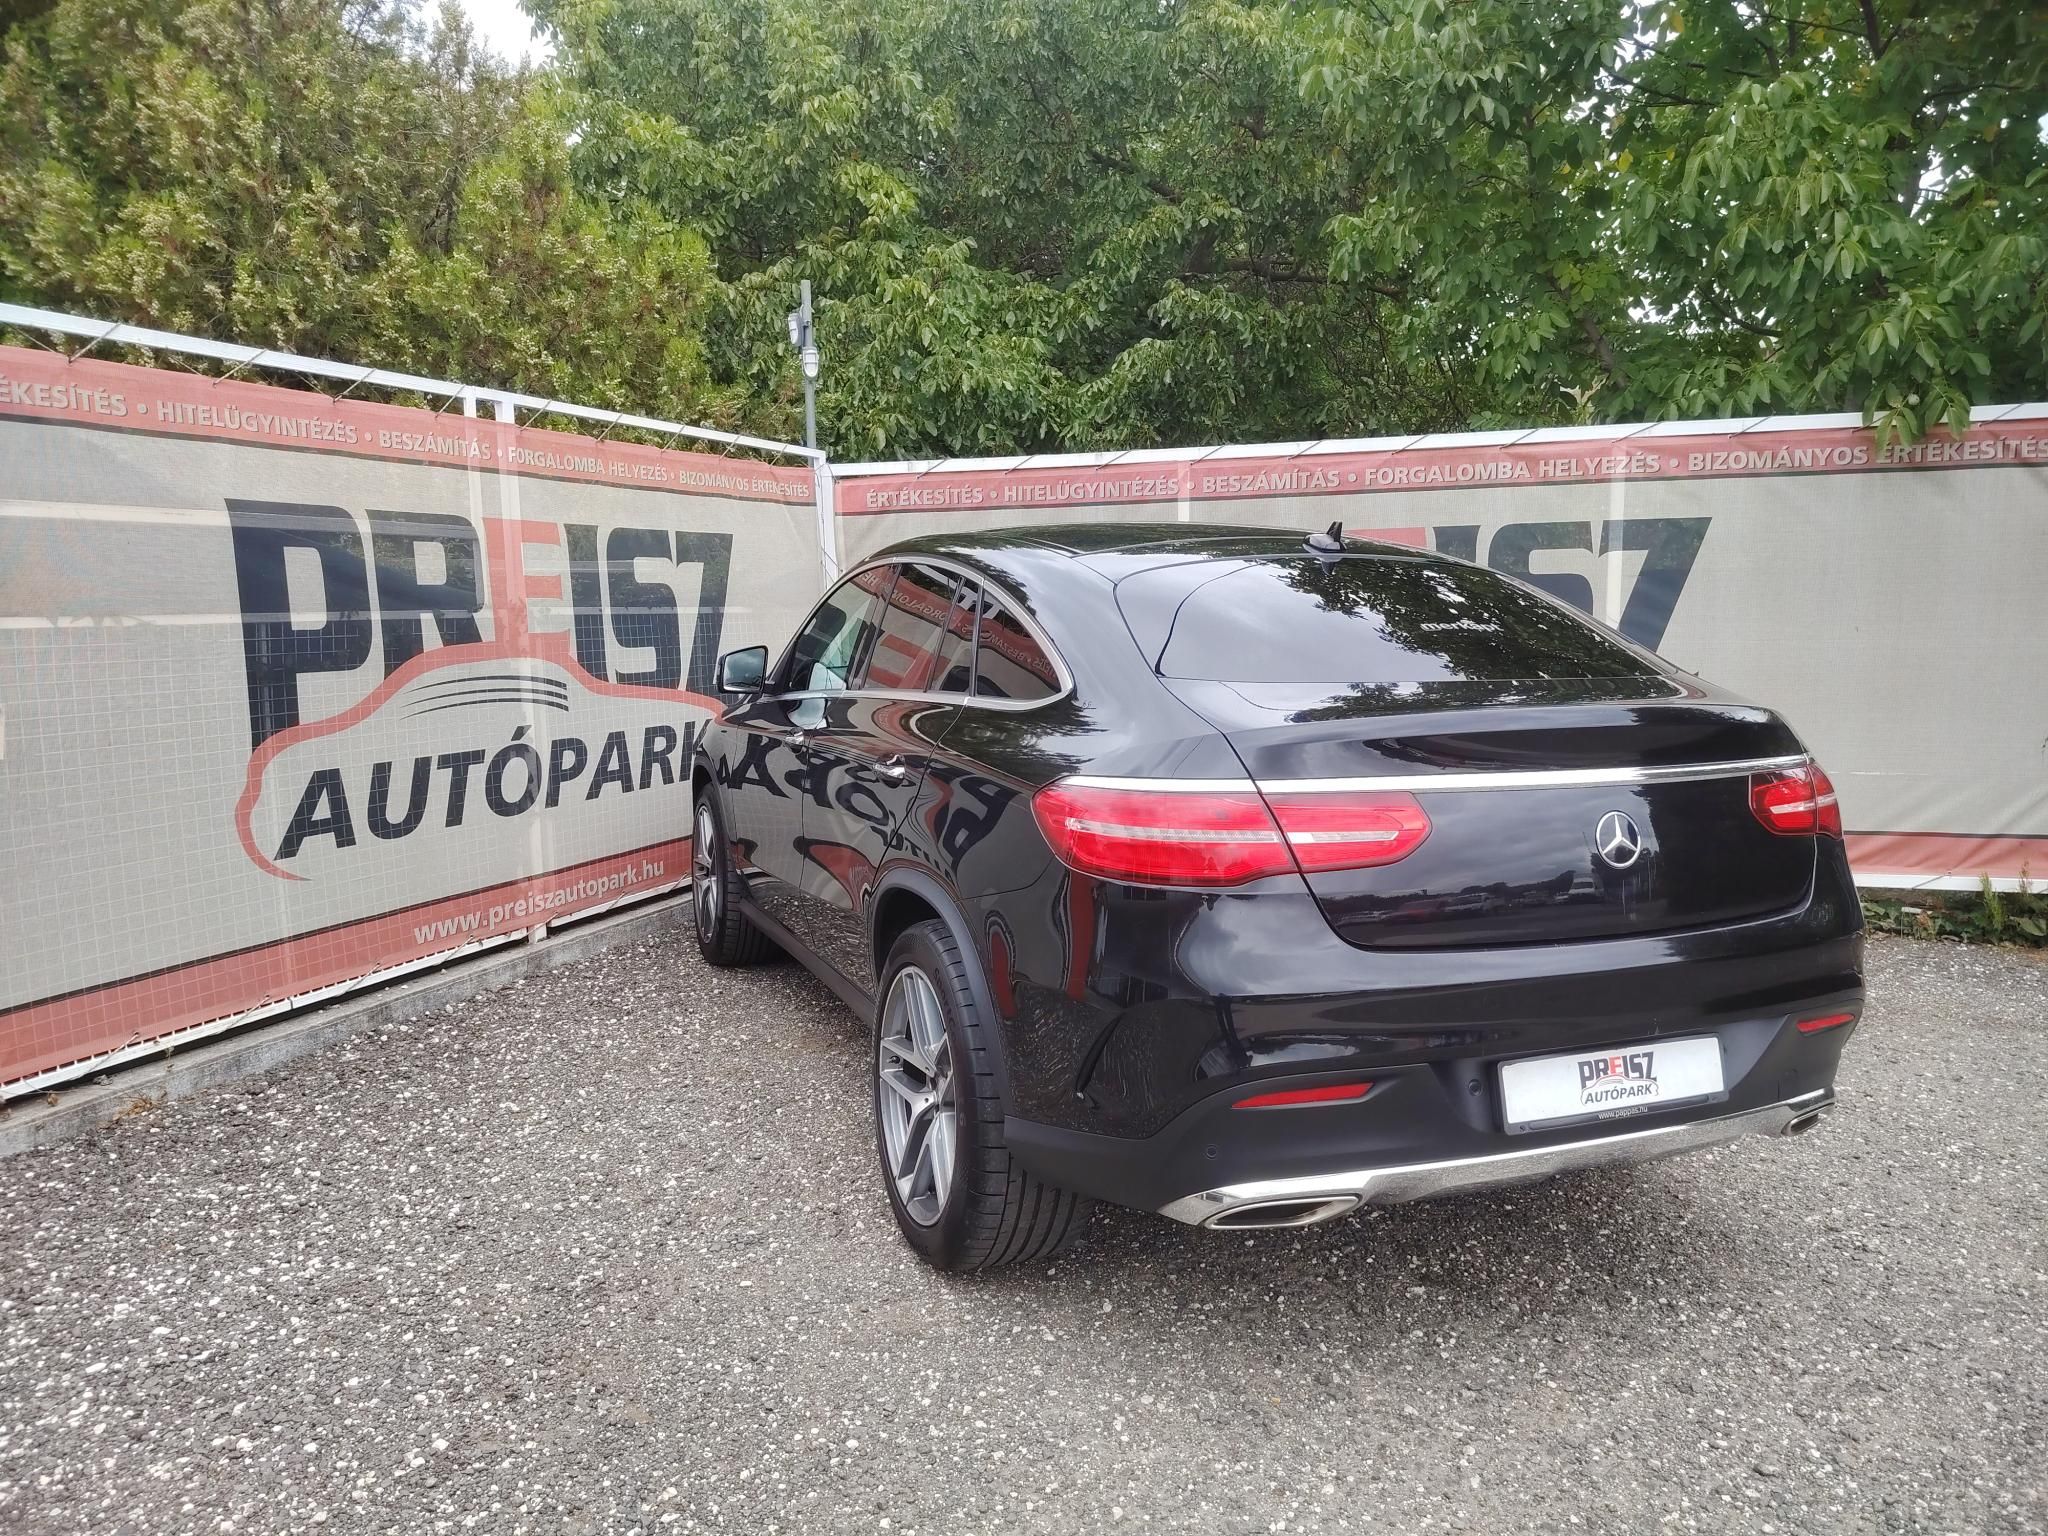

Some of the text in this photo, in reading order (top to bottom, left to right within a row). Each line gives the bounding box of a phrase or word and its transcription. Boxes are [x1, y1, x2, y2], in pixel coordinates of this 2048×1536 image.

[157, 400, 358, 443] HITELÜGYINTÉZÉS
[379, 429, 491, 461] BESZÁMÍTÁS
[508, 447, 605, 473] FORGALOMBA
[608, 461, 668, 483] HELYEZÉS
[679, 469, 750, 492] BIZOMÁNYOS
[866, 487, 984, 508] ÉRTÉKESÍTÉS
[1004, 475, 1179, 502] HITELÜGYINTÉZÉS
[1202, 468, 1341, 493] BESZÁMÍTÁS
[1365, 461, 1531, 486] FORGALOMBA
[1538, 453, 1661, 477] HELYEZÉS
[1688, 446, 1869, 471] BIZOMÁNYOS
[414, 860, 665, 944] www.preiszautopark.hu
[1577, 1051, 1657, 1089] PREISZ
[1584, 1084, 1653, 1105] AUTÓPARK
